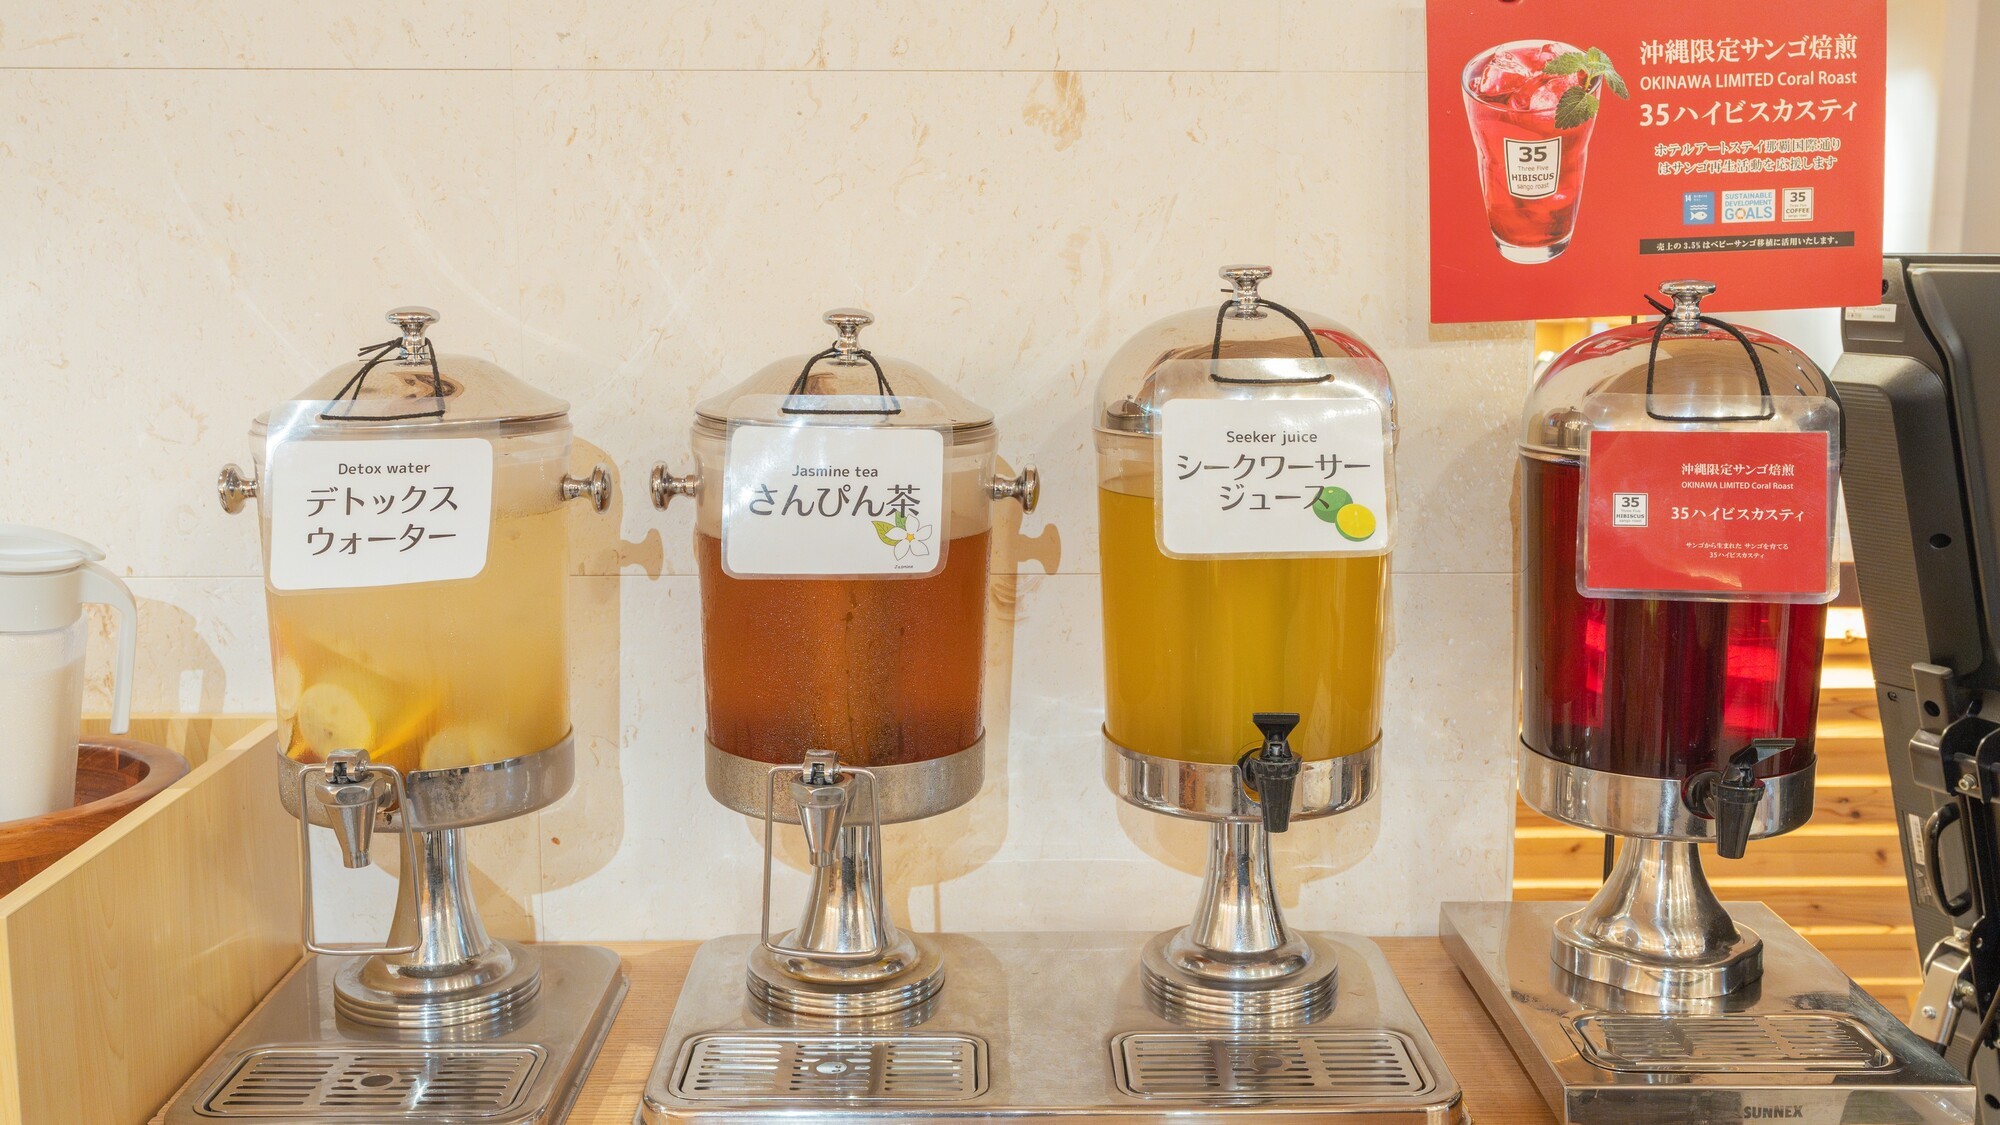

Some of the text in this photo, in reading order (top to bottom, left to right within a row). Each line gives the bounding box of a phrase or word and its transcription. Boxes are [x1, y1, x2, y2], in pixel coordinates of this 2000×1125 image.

[1640, 34, 1858, 65] 沖縄限定サンゴ焙煎
[1640, 70, 1858, 90] OKINAWA LIMITED Coral Roast
[1640, 98, 1858, 126] 35ハイビスカスティ
[1518, 146, 1548, 162] 35
[1655, 138, 1841, 157] ホテルアートステイ那覇国際通り
[1658, 155, 1838, 176] はサンゴ再生活動を応援します
[1512, 172, 1554, 182] HIBISCUS
[1725, 192, 1772, 200] SUSTAINABLE
[1790, 192, 1806, 202] 35
[1725, 206, 1772, 220] GOALS
[1226, 430, 1318, 446] Seeker juice
[338, 462, 431, 475] Detox water
[792, 464, 878, 478] Jasmine tea
[1177, 454, 1370, 480] シークワーサー
[1682, 463, 1794, 476] 沖縄限定サンゴ焙煎
[1682, 481, 1718, 489] OKINAWA
[1752, 482, 1771, 490] Coral
[306, 486, 458, 517] デトックス
[749, 484, 920, 518] さんぴん茶
[1219, 483, 1330, 512] ジュース
[1622, 496, 1640, 508] 35
[1671, 506, 1804, 522] 35ハイビスカスティ
[307, 523, 456, 556] ウォーター
[1744, 1105, 1803, 1119] SUNNEX
